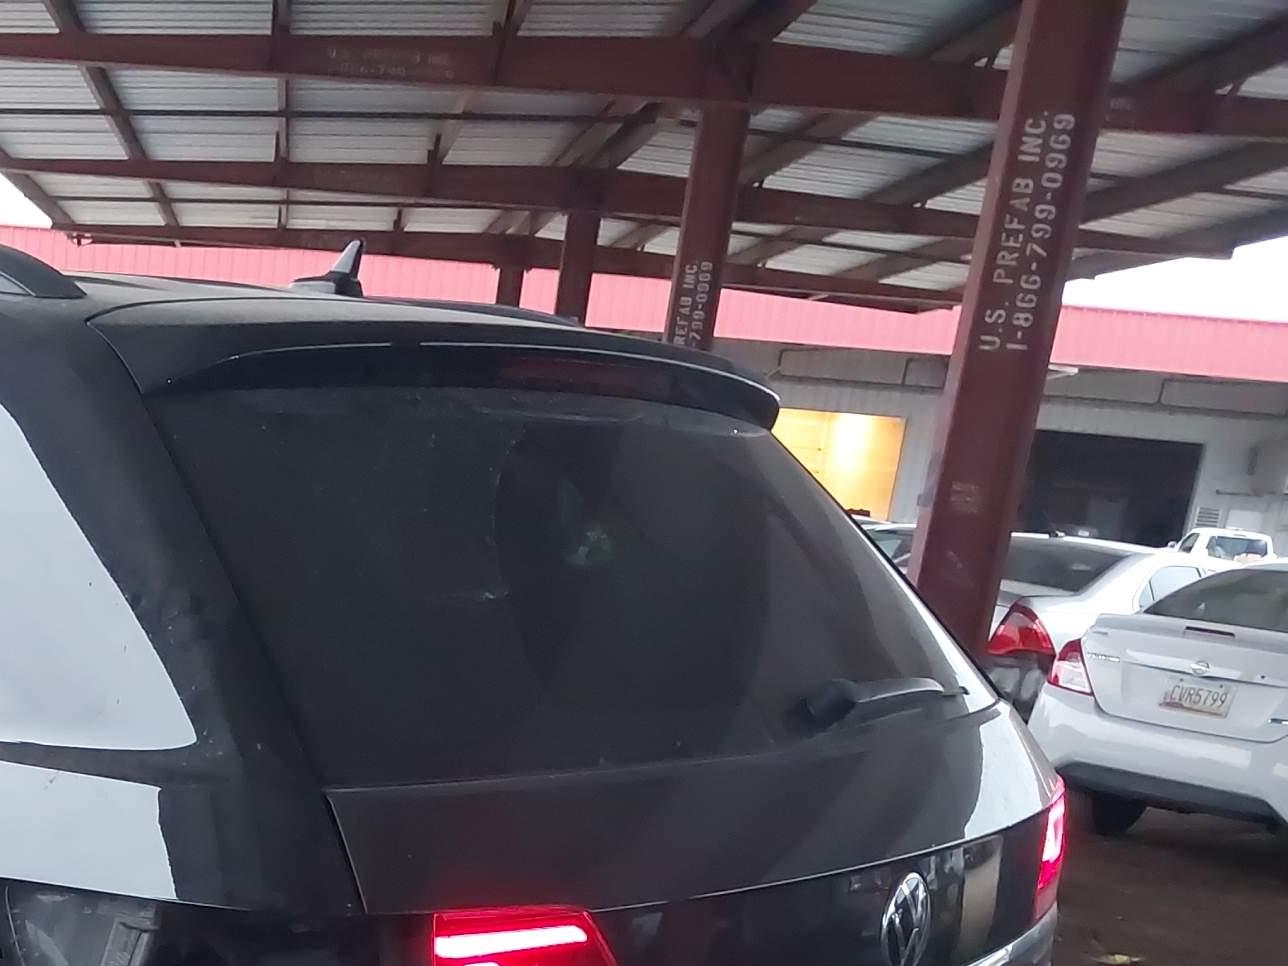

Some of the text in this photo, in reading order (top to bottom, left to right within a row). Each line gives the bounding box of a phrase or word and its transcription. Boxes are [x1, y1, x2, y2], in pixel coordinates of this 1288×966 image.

[673, 296, 692, 345] REFAB
[979, 111, 1048, 351] U.S. PREFAB INC.
[1006, 113, 1075, 351] 1-866-799-0969
